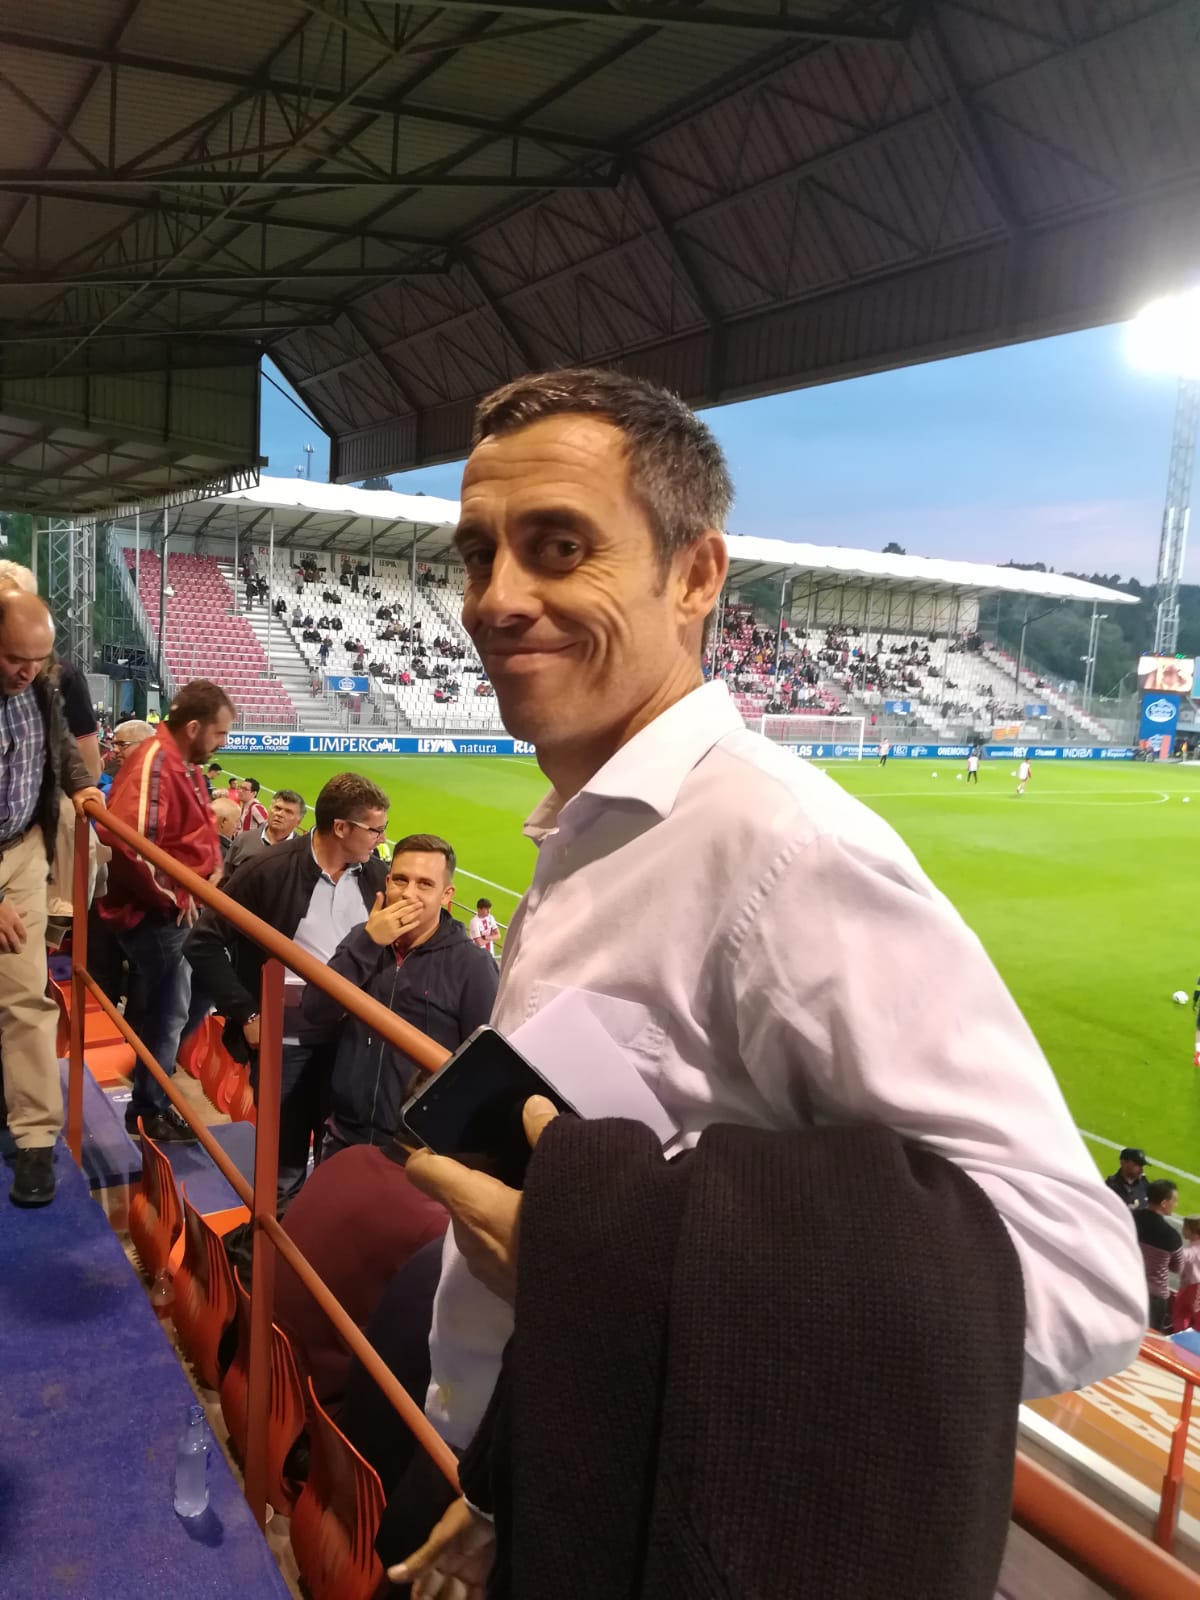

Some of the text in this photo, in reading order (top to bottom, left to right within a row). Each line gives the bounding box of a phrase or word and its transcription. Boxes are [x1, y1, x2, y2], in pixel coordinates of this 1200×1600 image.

[262, 735, 290, 746] Gold
[309, 737, 401, 753] LIMPERGAL
[417, 738, 497, 753] LEYMA natura
